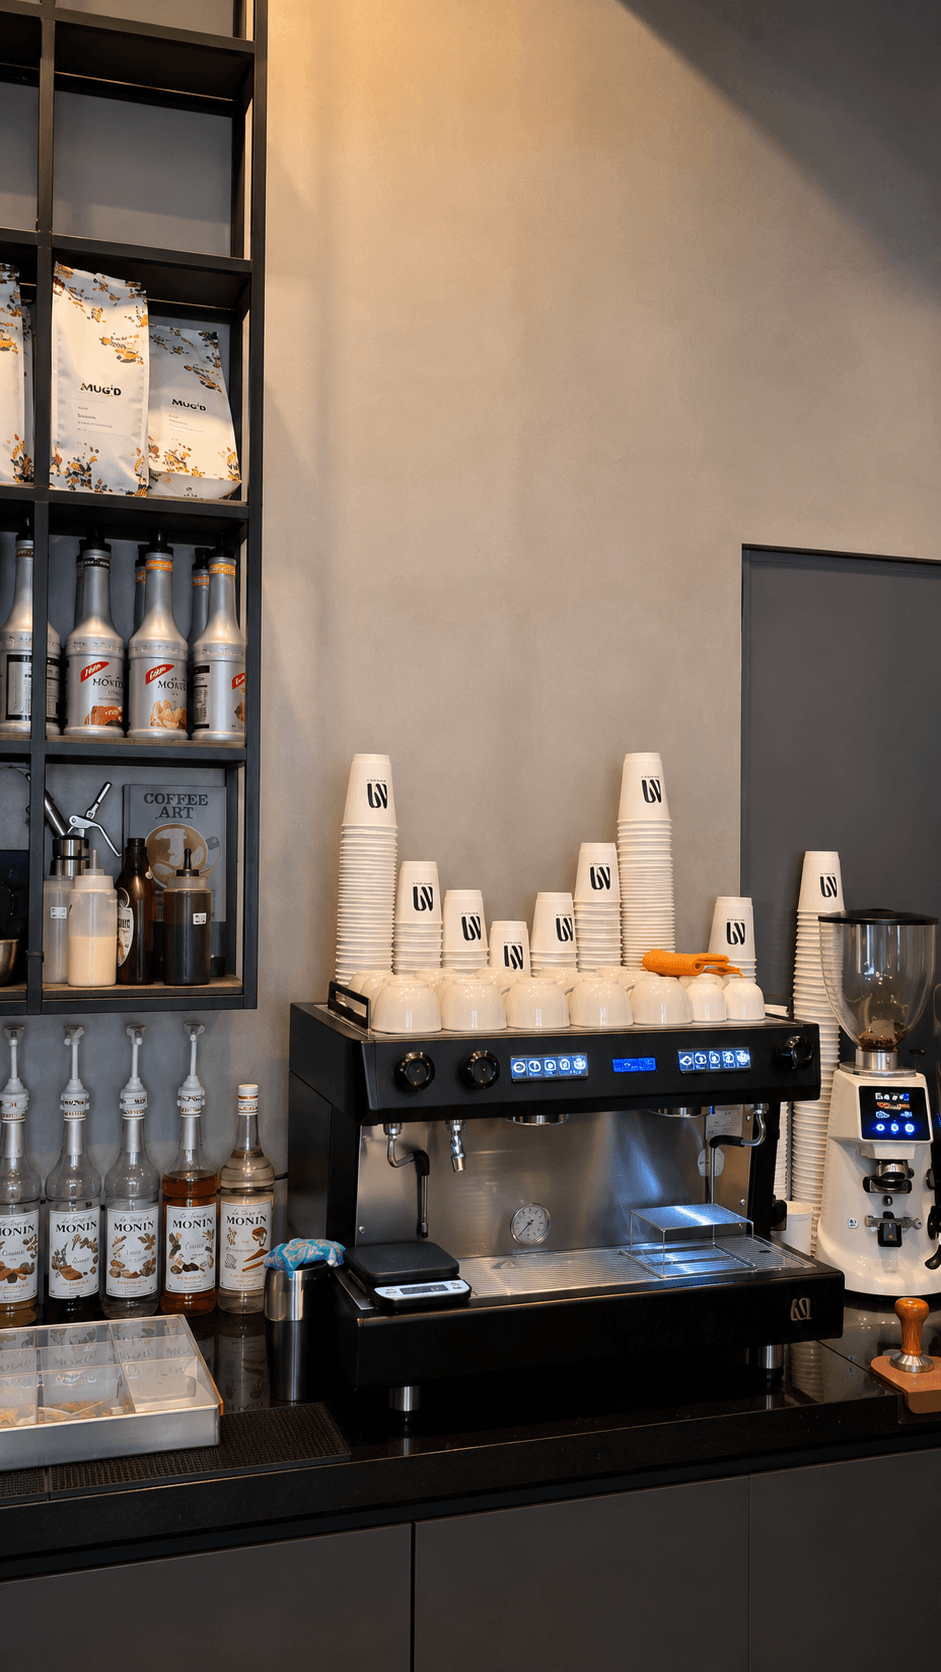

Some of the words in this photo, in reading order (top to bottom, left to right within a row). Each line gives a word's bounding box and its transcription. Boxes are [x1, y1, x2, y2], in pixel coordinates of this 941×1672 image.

[80, 382, 122, 396] MUG'D
[171, 398, 207, 411] MUG'D
[143, 792, 208, 806] COFFEE
[155, 806, 194, 819] ART
[55, 1220, 97, 1233] MONIN
[113, 1220, 154, 1233] MONIN
[172, 1217, 214, 1229] MONIN
[226, 1214, 267, 1226] MONIN
